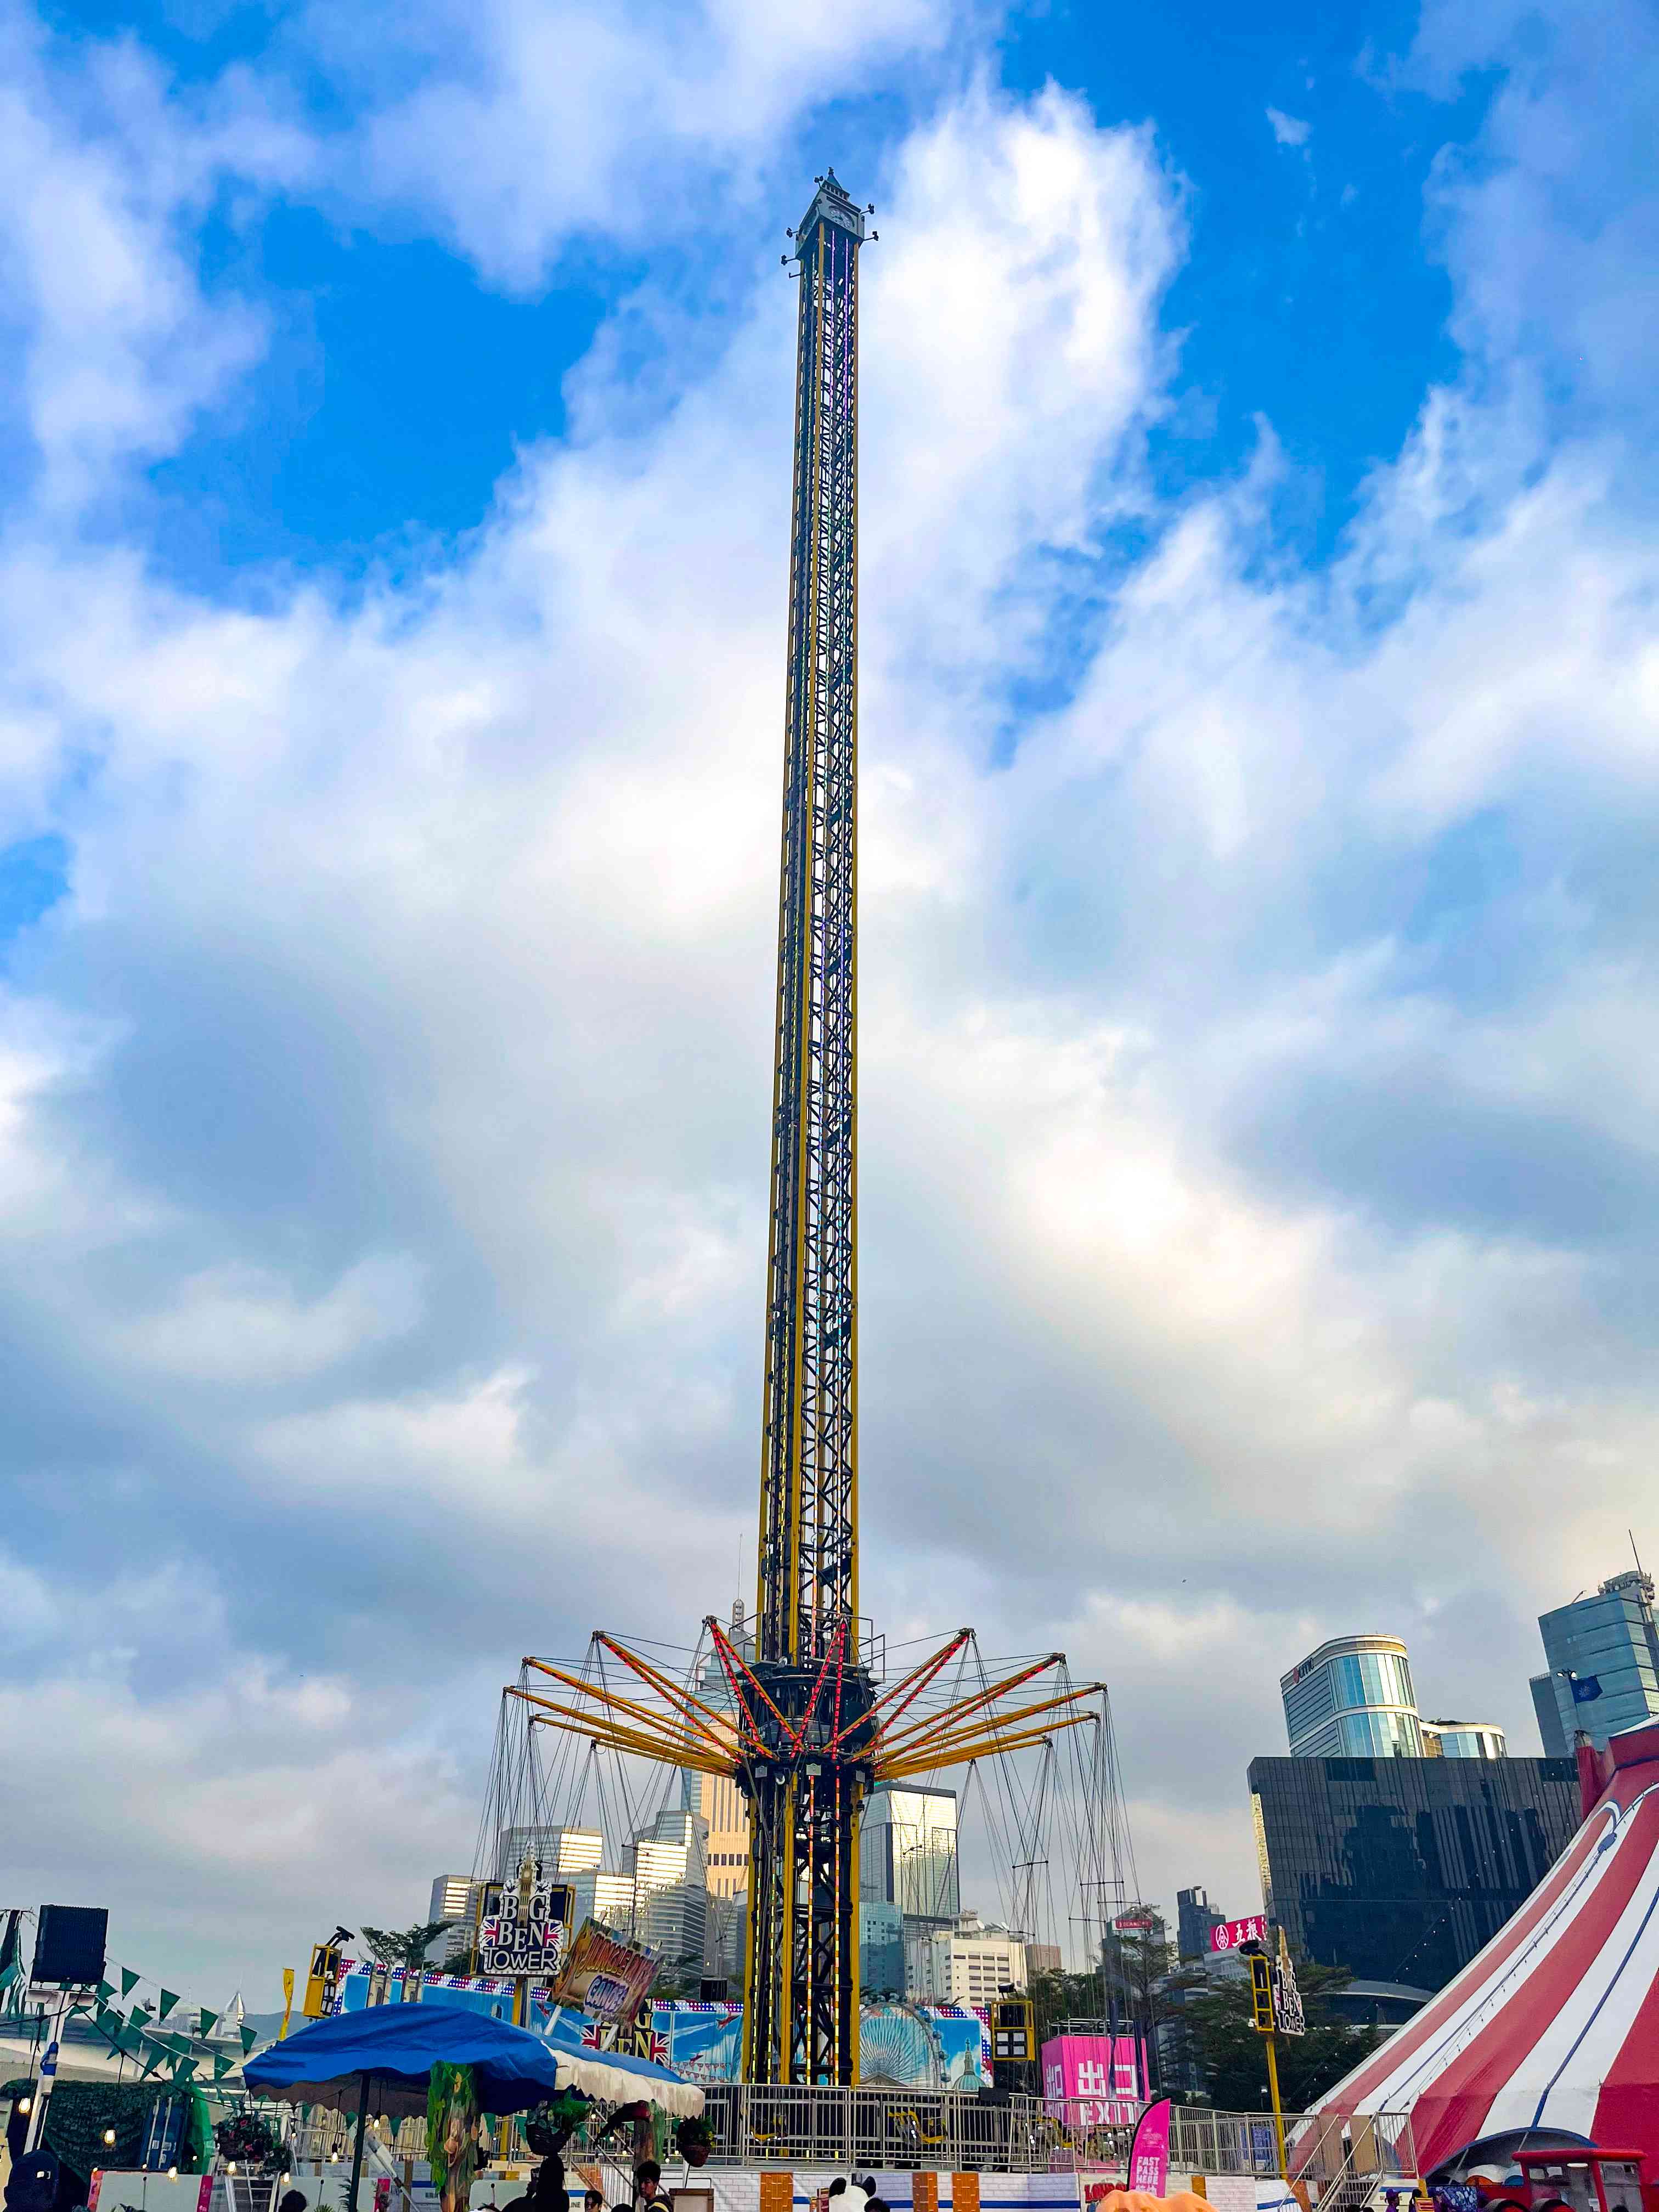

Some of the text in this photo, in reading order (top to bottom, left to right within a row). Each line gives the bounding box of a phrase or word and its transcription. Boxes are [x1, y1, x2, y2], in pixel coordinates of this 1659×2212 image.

[497, 1921, 546, 1952] BEN
[484, 1947, 556, 1970] TOWER
[575, 1931, 634, 1979] JUNGLE
[1282, 1990, 1299, 2017] BEN
[1280, 2010, 1305, 2033] TOWER
[1077, 2060, 1137, 2097] 出口
[1079, 2101, 1138, 2126] EXIT
[1137, 2156, 1160, 2166] FAST
[1137, 2166, 1159, 2175] PASS
[1136, 2175, 1158, 2185] HERE
